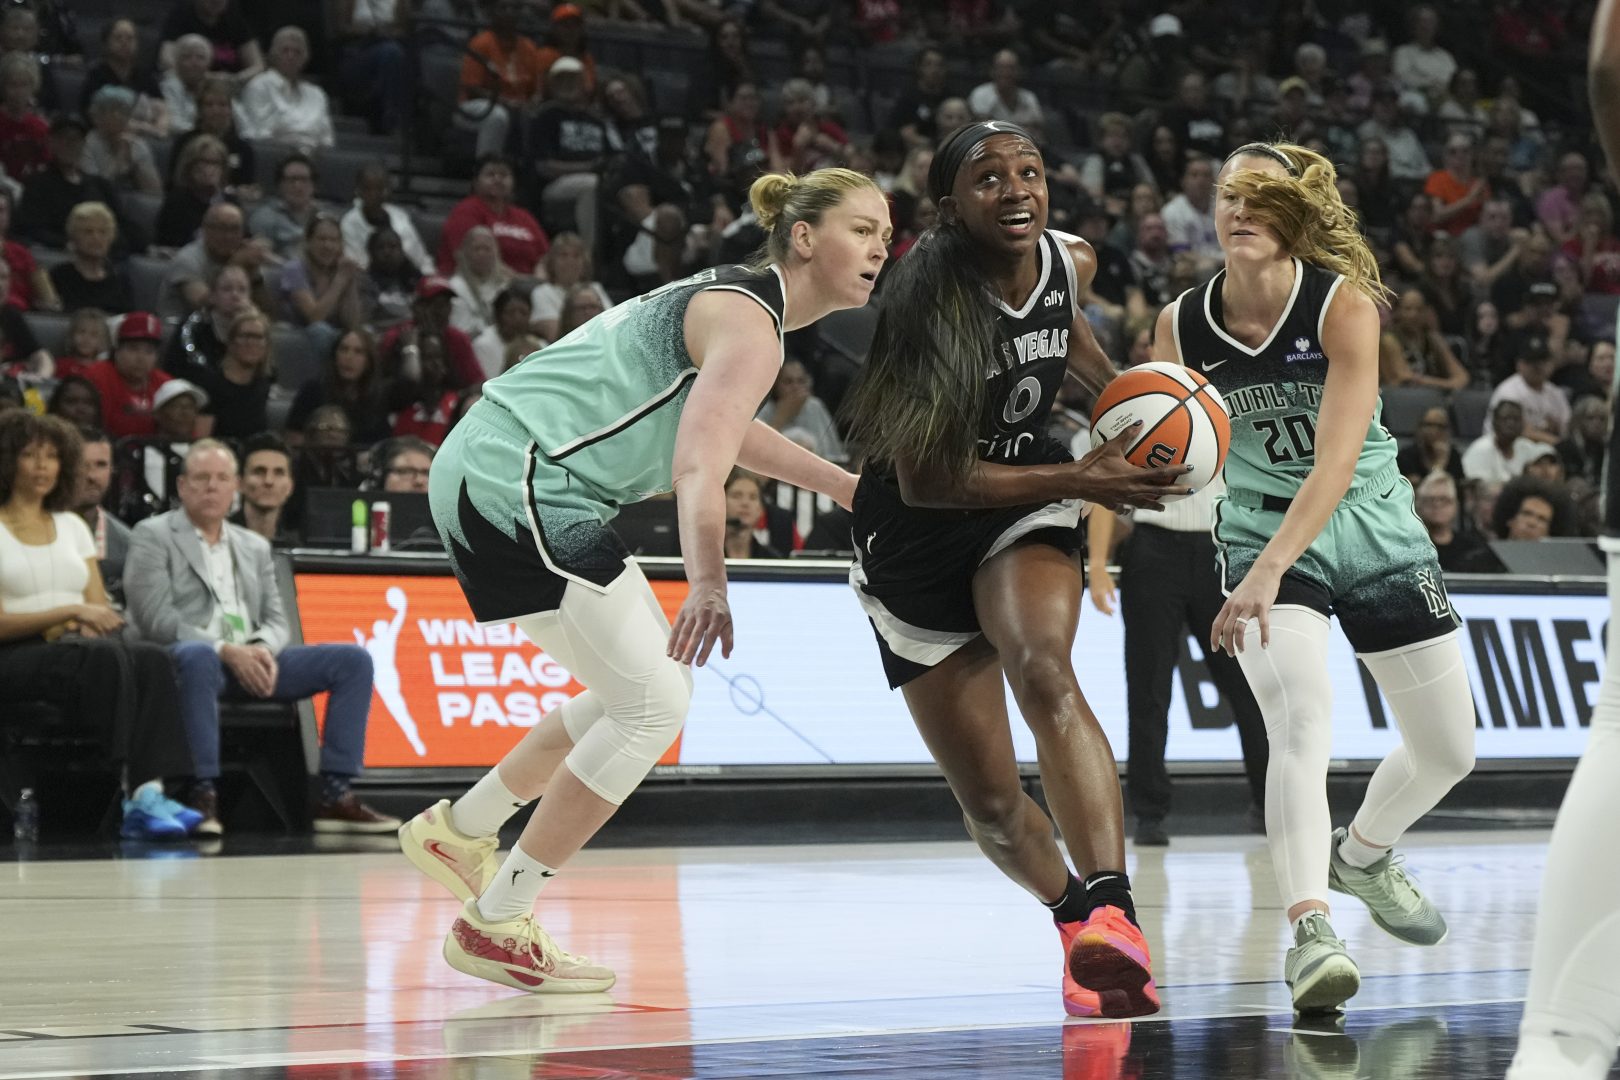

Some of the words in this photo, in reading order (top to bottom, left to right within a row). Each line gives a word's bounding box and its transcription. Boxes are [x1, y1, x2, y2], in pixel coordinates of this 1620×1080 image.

[1044, 289, 1065, 308] ally
[1013, 328, 1069, 365] VEGAS
[1286, 352, 1323, 362] BARCLAYS
[1003, 376, 1042, 424] 0
[1251, 410, 1317, 465] 20
[428, 652, 571, 687] LEAG
